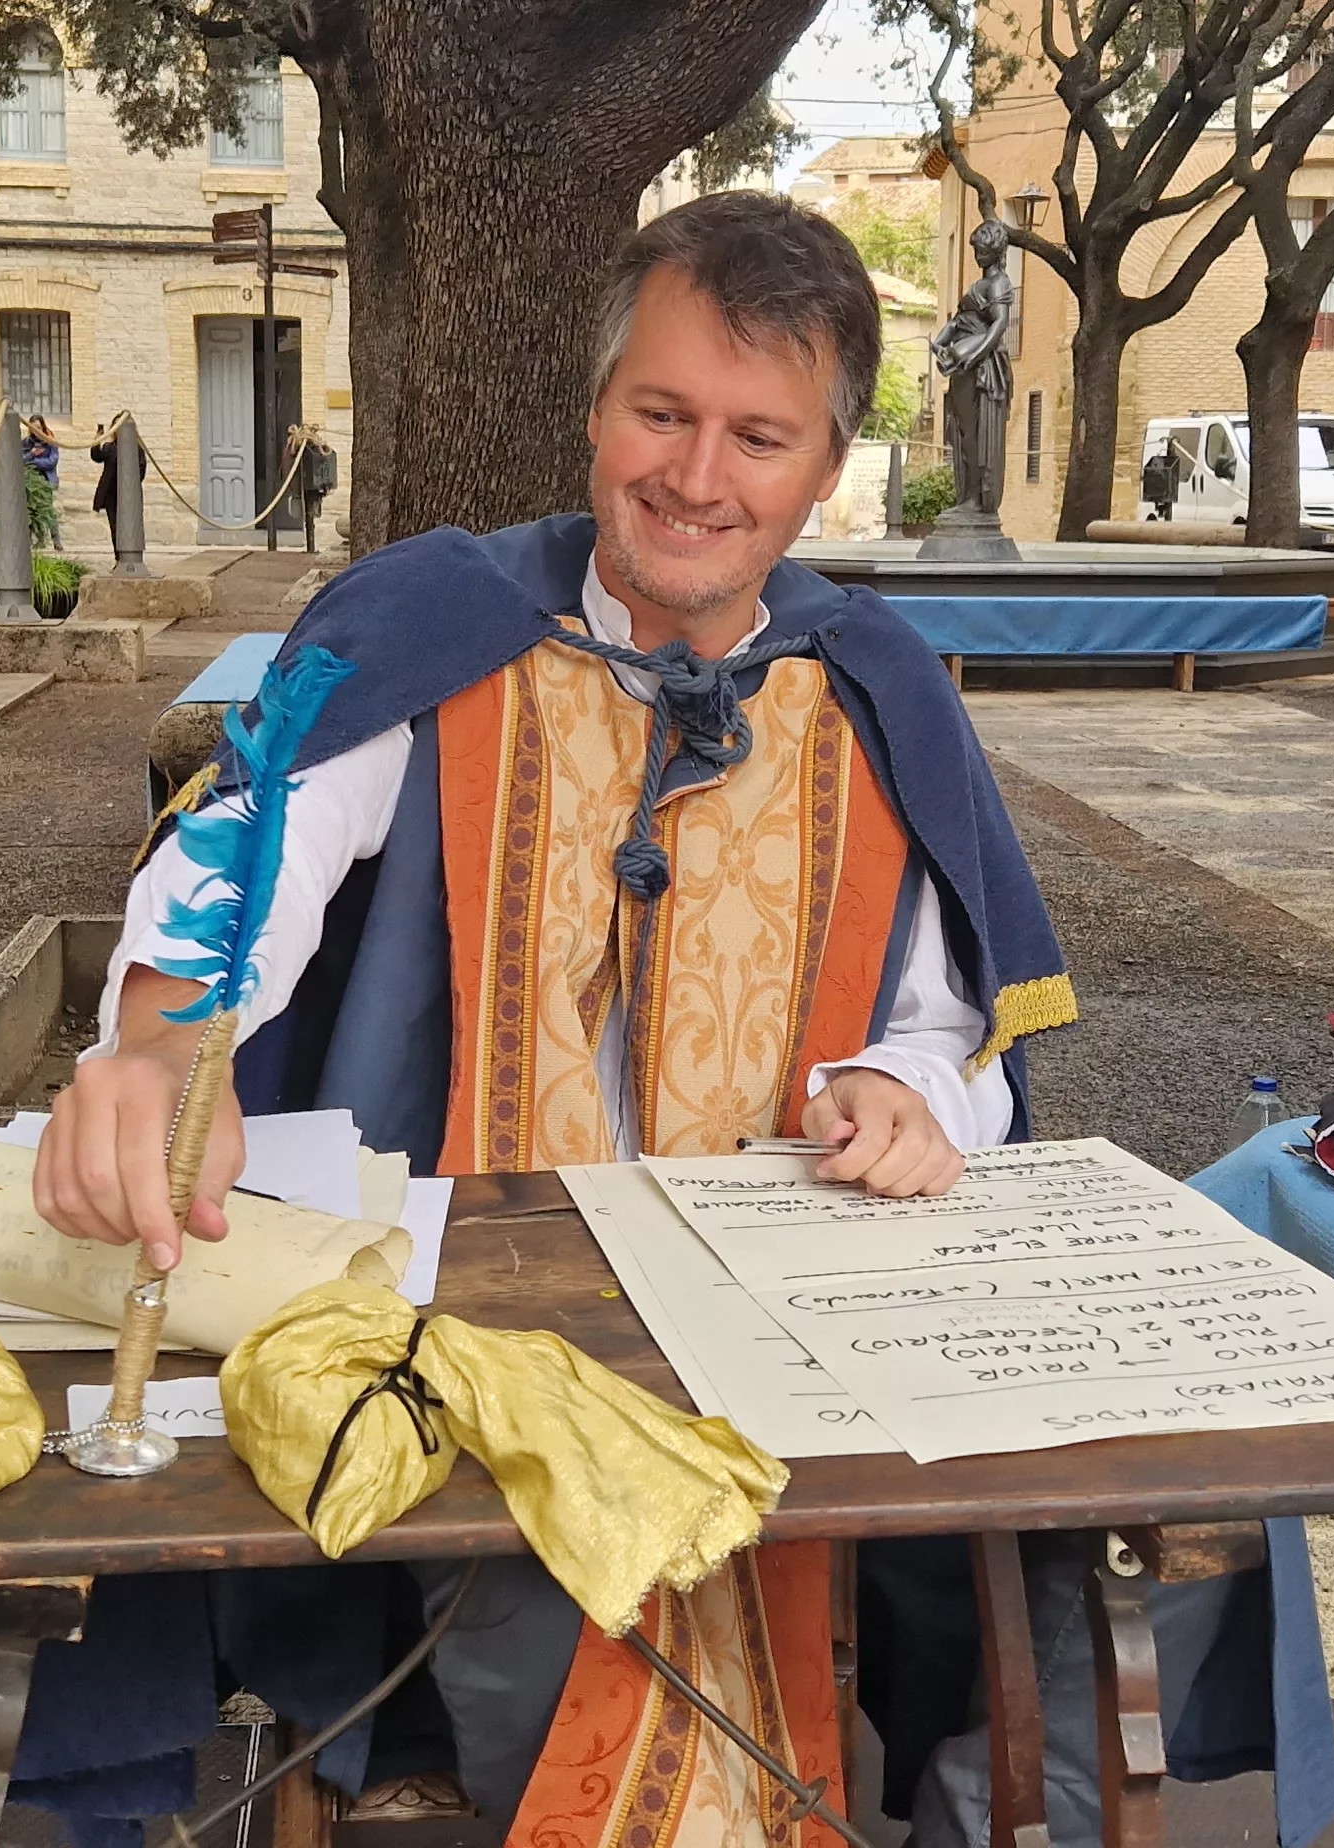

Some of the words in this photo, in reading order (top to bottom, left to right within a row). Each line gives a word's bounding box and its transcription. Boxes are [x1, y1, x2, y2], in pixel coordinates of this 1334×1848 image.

[242, 288, 253, 302] 3
[667, 1177, 796, 1195] ARTESANO
[1025, 1184, 1150, 1201] SORTEO
[1034, 1201, 1174, 1218] APERTURA
[973, 1223, 1081, 1239] LLAVES
[1012, 1239, 1048, 1250] EL
[1065, 1232, 1139, 1248] ENTRE
[1156, 1258, 1272, 1277] REINA
[1032, 1272, 1142, 1291] MARÍA
[1231, 1284, 1316, 1301] (PAGO
[1077, 1298, 1222, 1318] NOTARIO)
[1178, 1313, 1261, 1328] PLICA
[851, 1324, 1102, 1355] (SECRETARIO)
[1193, 1327, 1278, 1342] PLICA
[941, 1338, 1120, 1363] (NOTARIO)
[968, 1361, 1090, 1381] PRIOR
[1043, 1404, 1225, 1431] JURADOS
